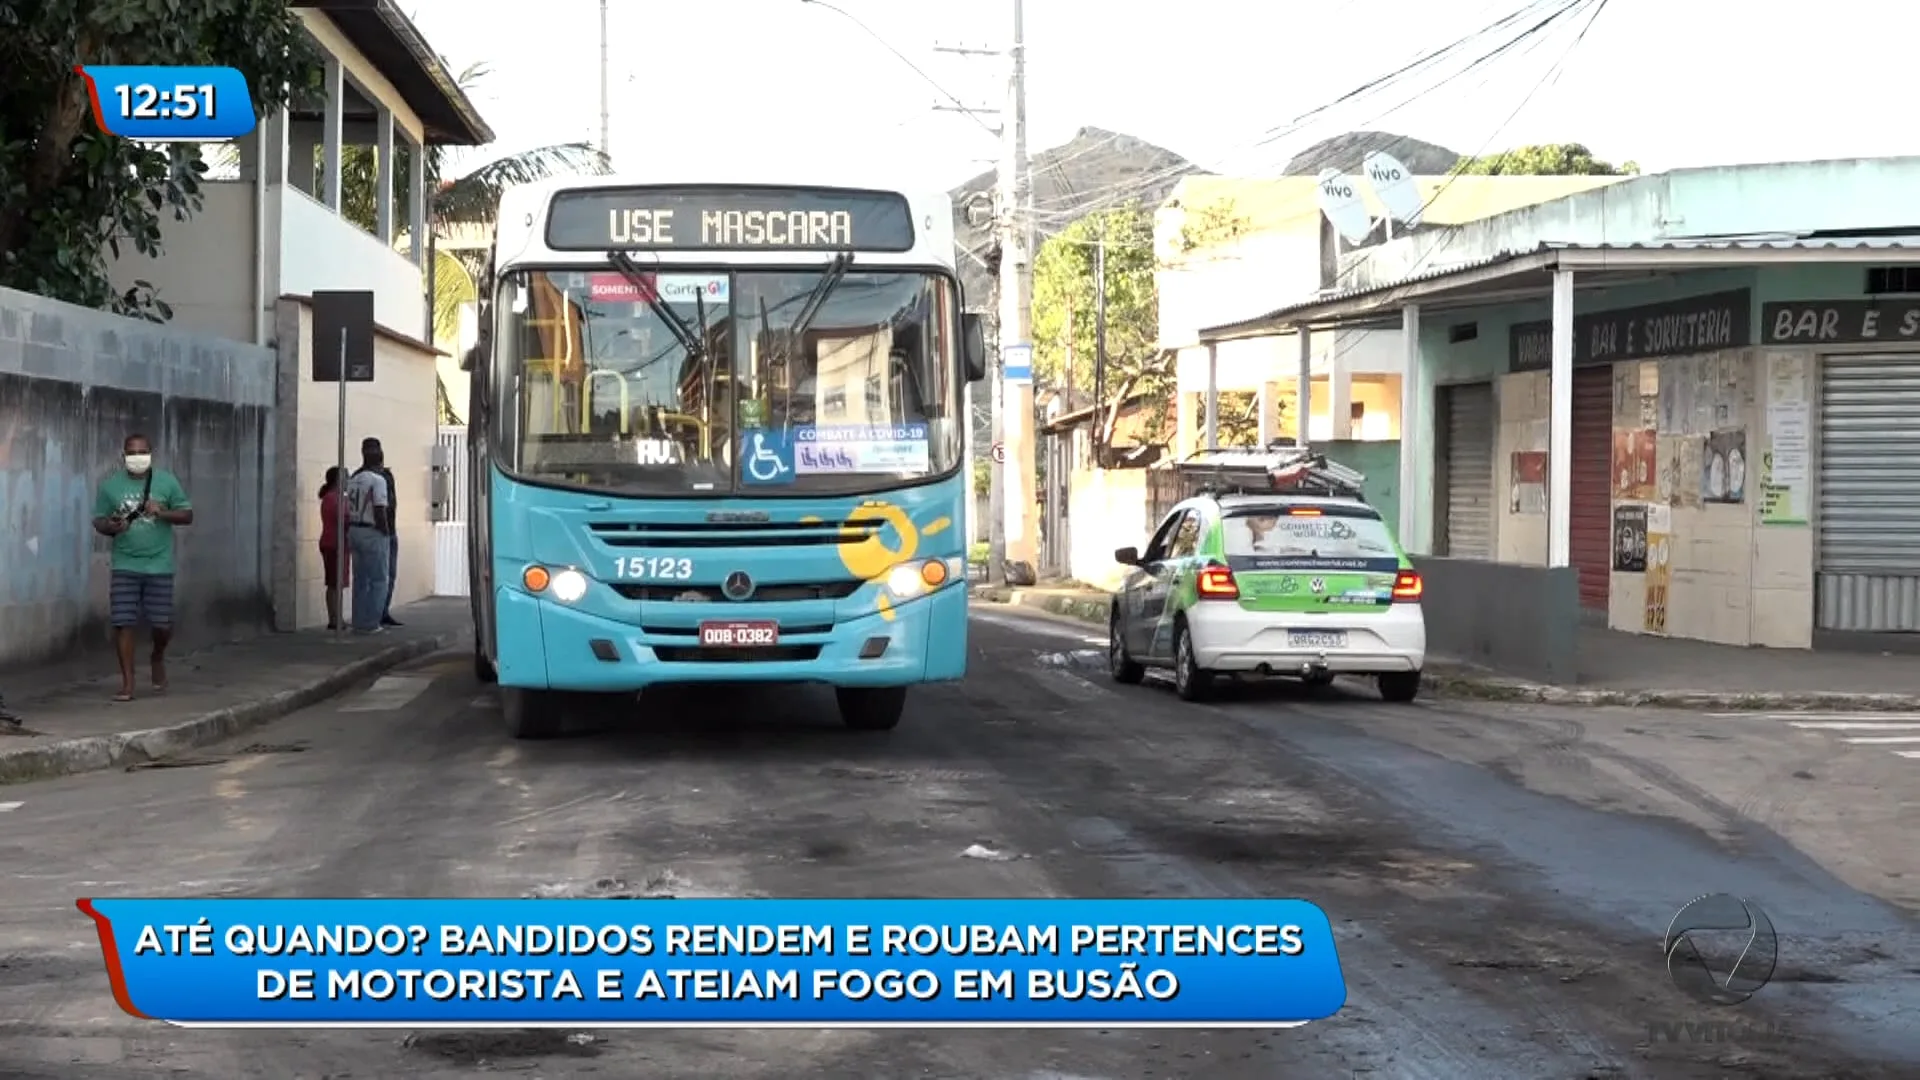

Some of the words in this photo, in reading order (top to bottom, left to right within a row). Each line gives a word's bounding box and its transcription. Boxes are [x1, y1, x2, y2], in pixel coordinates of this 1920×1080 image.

[1369, 163, 1401, 181] vivo
[1323, 179, 1352, 198] vivo
[609, 208, 674, 244] USE
[701, 209, 851, 245] MASCARA
[1773, 309, 1839, 340] BAR
[1860, 310, 1881, 338] E
[1590, 321, 1618, 359] BAR
[1625, 318, 1636, 354] E
[614, 556, 694, 580] 15123
